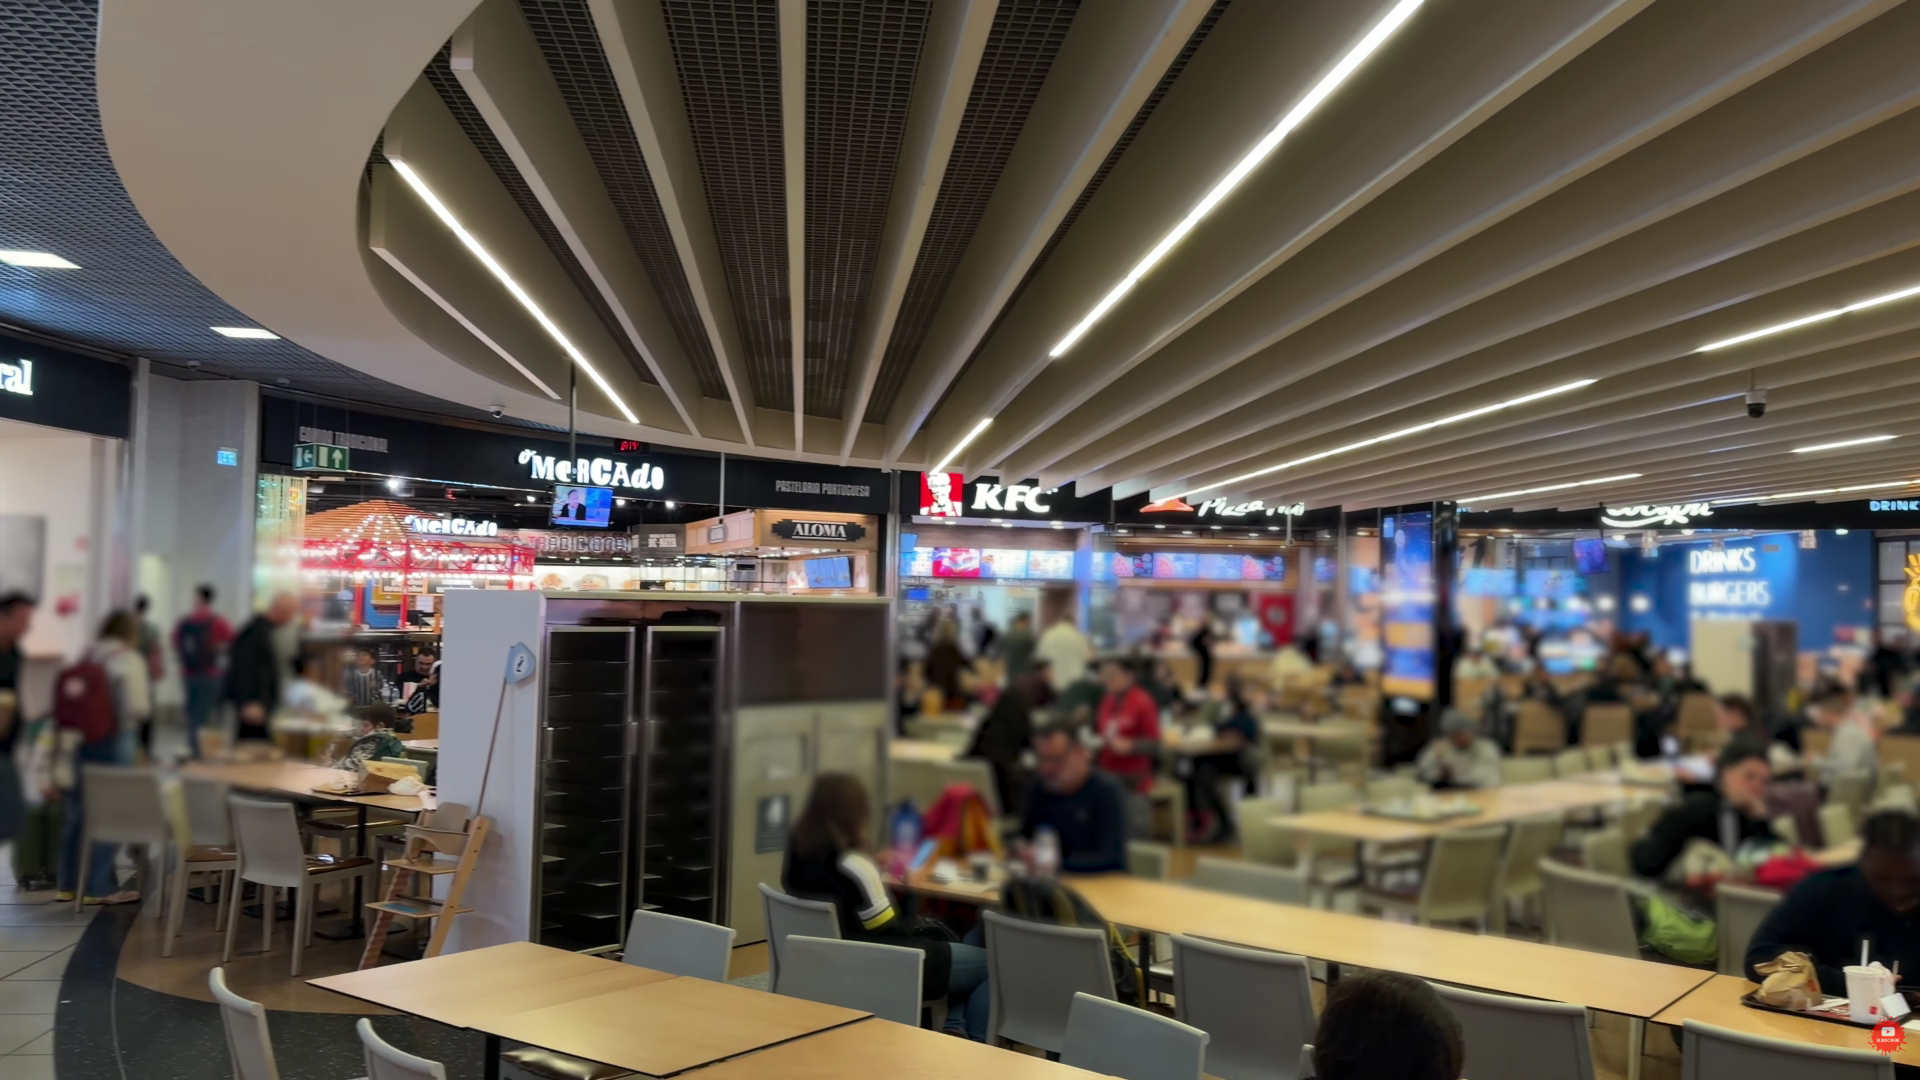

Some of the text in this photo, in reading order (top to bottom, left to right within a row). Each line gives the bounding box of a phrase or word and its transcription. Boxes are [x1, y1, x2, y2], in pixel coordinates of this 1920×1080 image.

[971, 483, 1051, 513] KFC
[1869, 500, 1920, 511] DRINK
[793, 523, 847, 538] ALOMA
[1689, 547, 1756, 574] DRINKS
